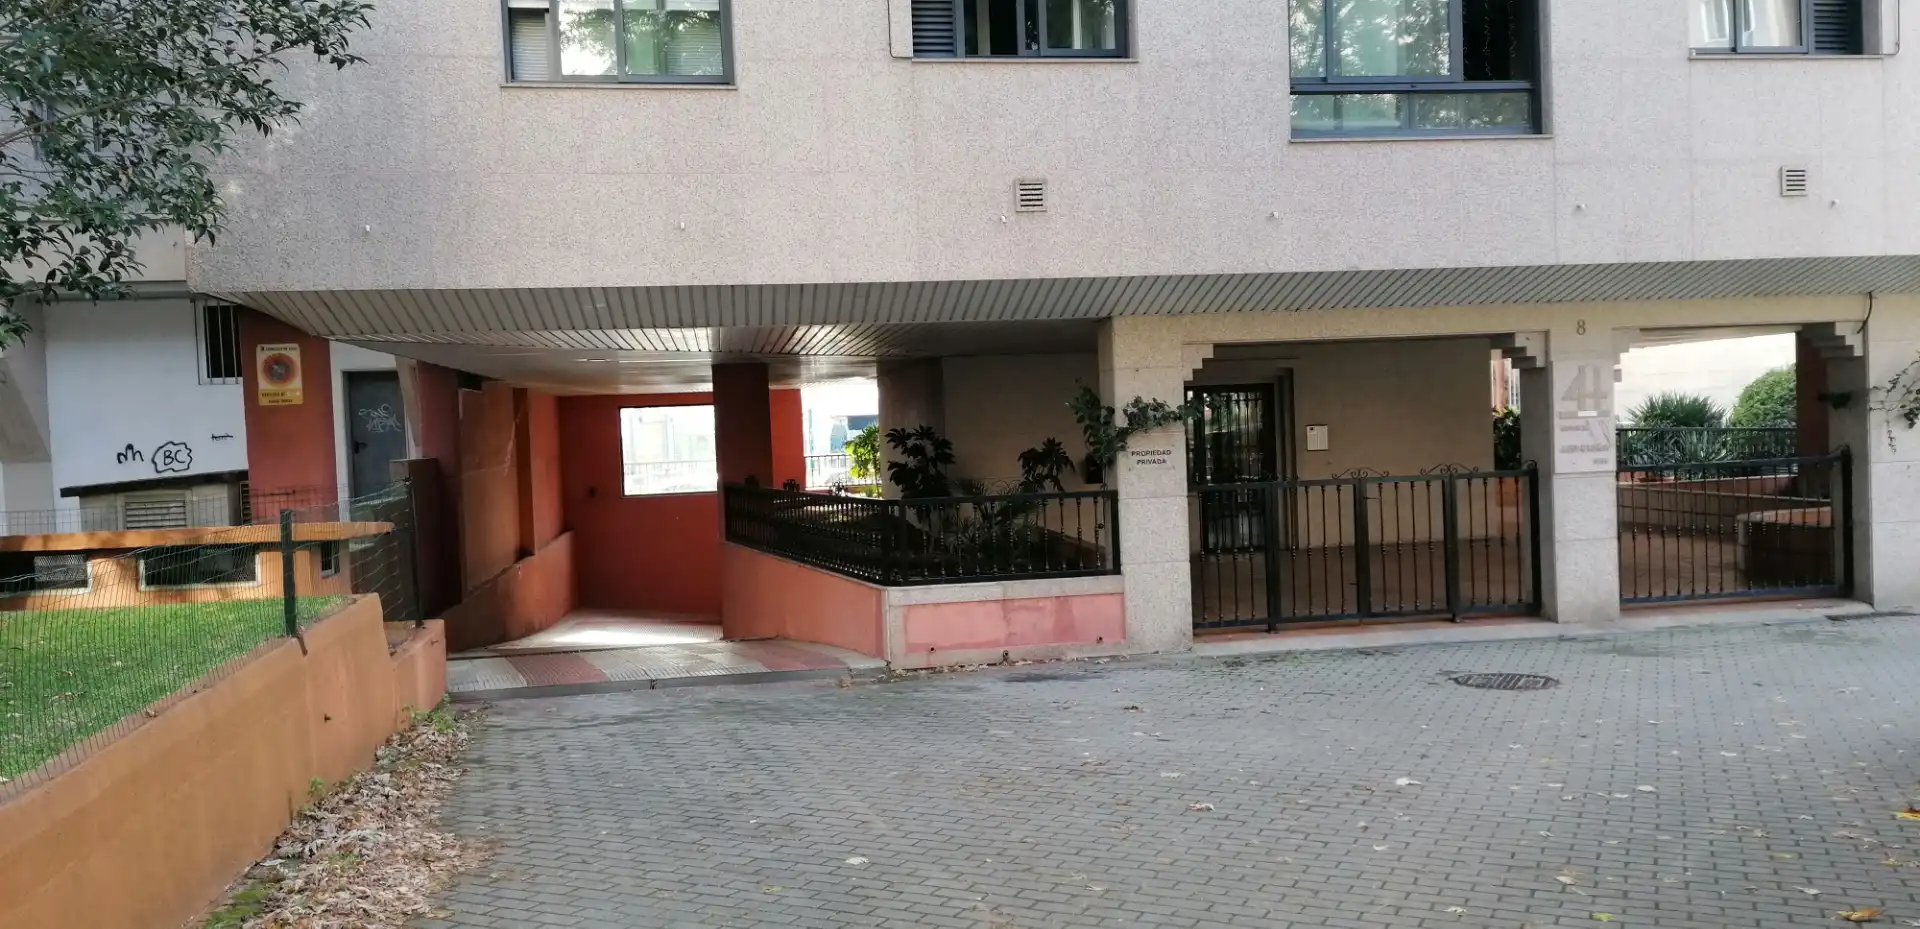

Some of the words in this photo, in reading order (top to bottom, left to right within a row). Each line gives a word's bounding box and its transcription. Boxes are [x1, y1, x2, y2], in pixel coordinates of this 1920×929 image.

[1576, 319, 1587, 336] 8
[163, 449, 186, 466] BC
[1131, 449, 1172, 457] PROPIEDAD
